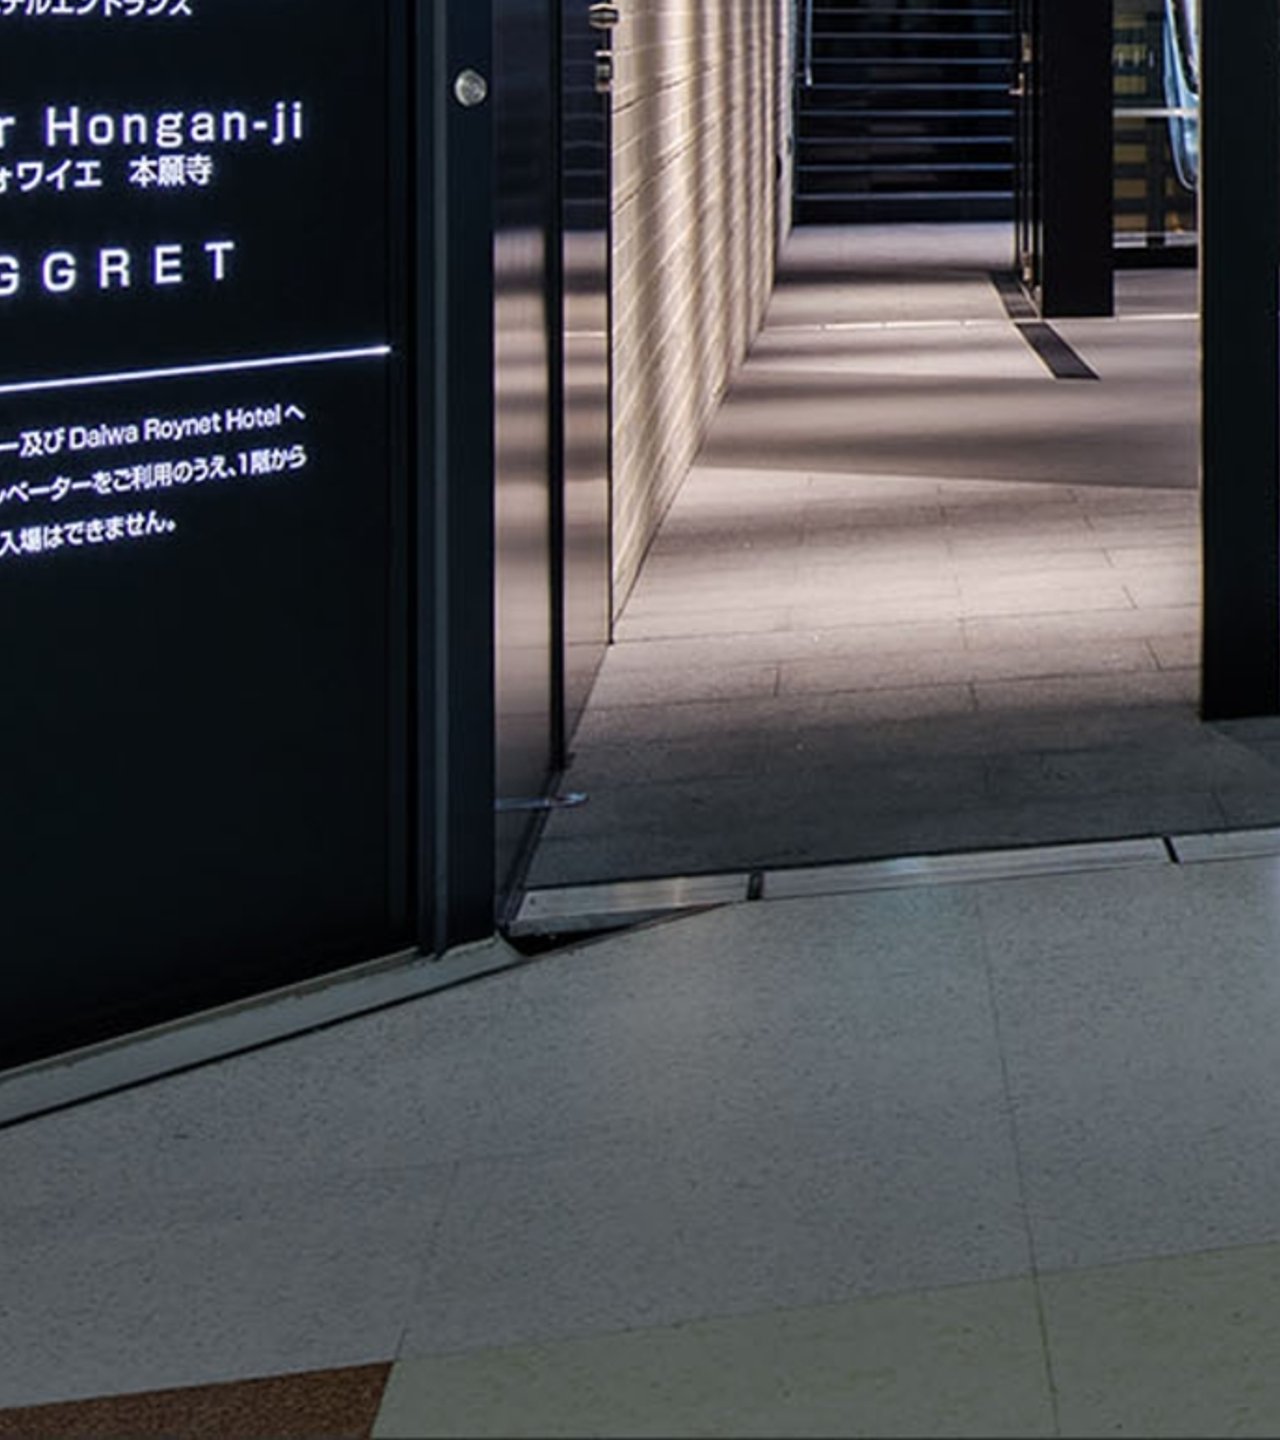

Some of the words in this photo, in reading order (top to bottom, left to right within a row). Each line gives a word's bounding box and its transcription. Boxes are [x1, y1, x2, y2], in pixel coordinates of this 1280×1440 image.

[46, 101, 302, 148] Hongan-ji
[129, 153, 213, 187] 本願寺
[69, 423, 140, 450] Daiwa
[144, 411, 221, 441] Roynet
[226, 403, 281, 432] Hotel
